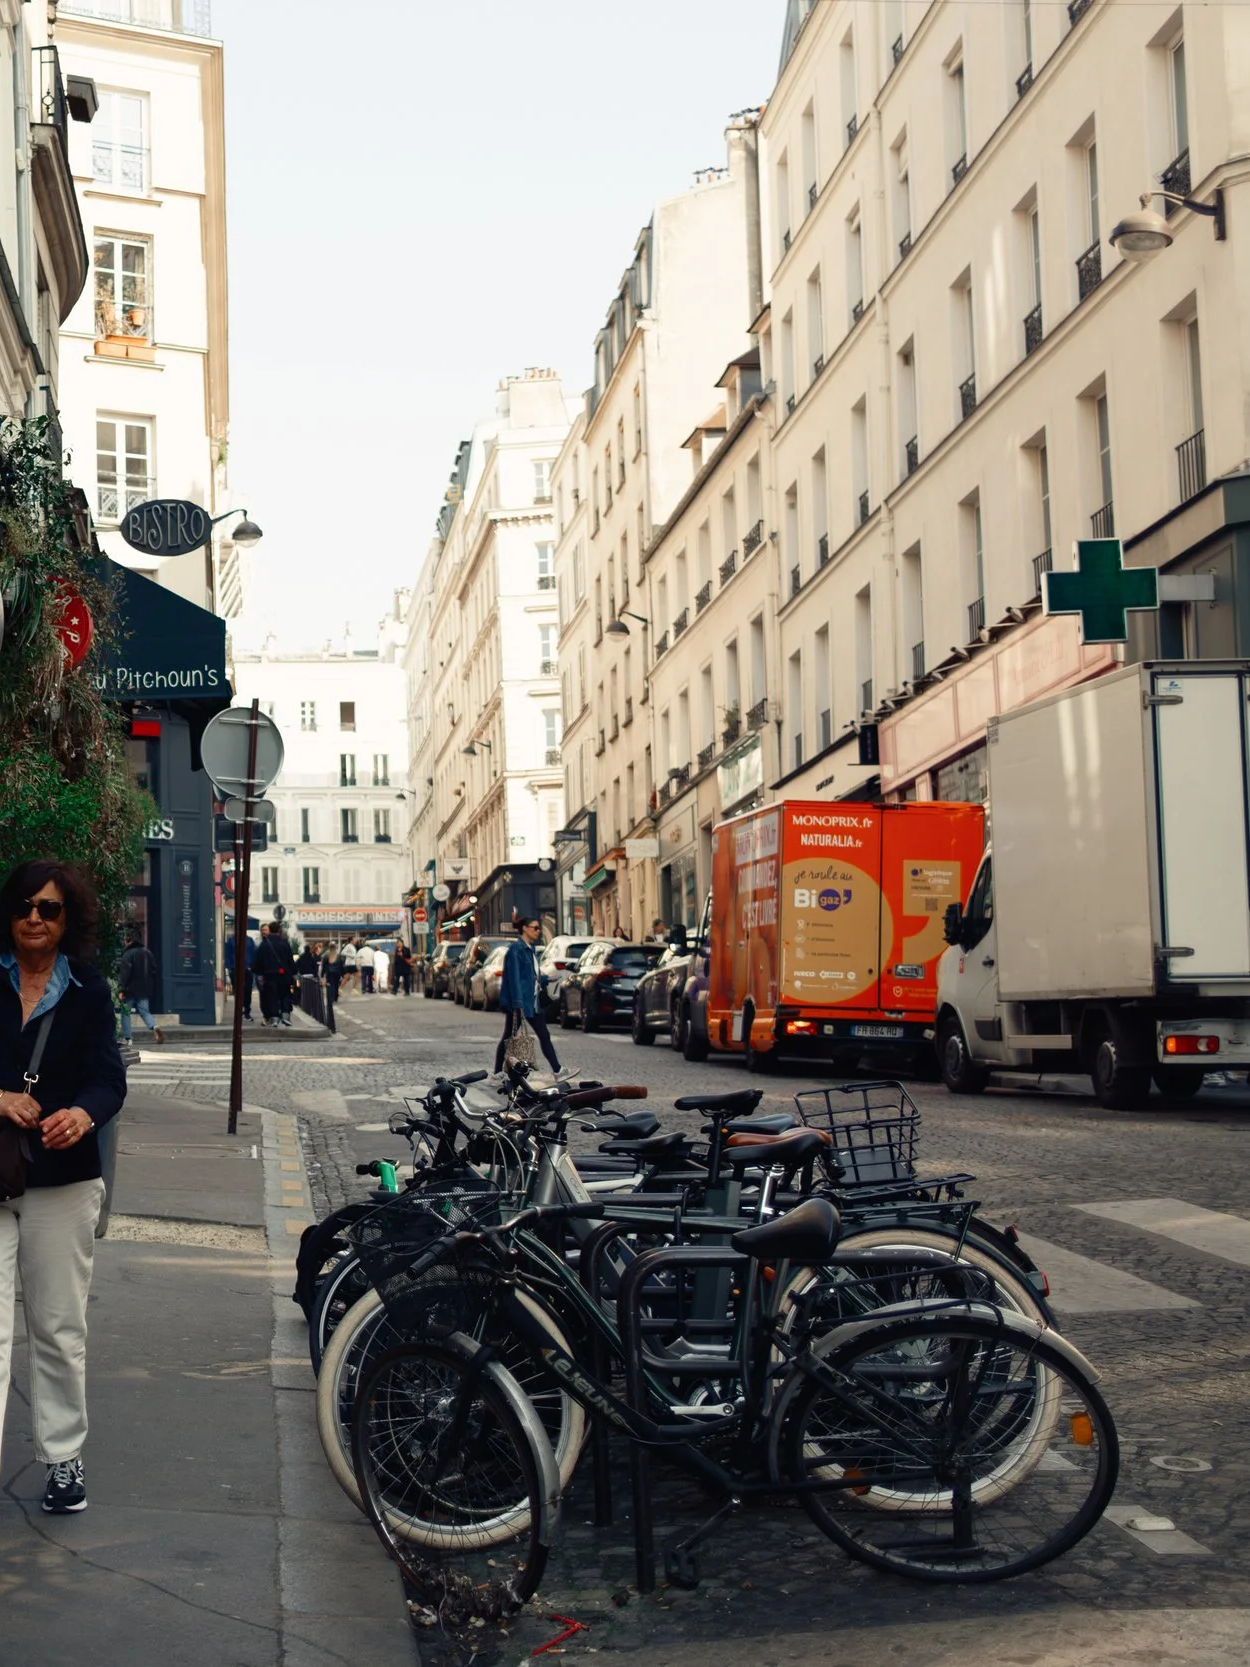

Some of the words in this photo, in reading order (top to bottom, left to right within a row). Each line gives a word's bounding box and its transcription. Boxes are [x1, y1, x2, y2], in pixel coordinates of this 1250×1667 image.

[129, 503, 205, 550] BISTRO
[116, 664, 219, 690] Pitchoun's
[792, 814, 873, 829] MONOPRIX.fr
[800, 833, 863, 848] NATURALIA.fr
[808, 865, 838, 881] roule
[839, 872, 853, 881] au
[301, 911, 356, 922] PAPIERS
